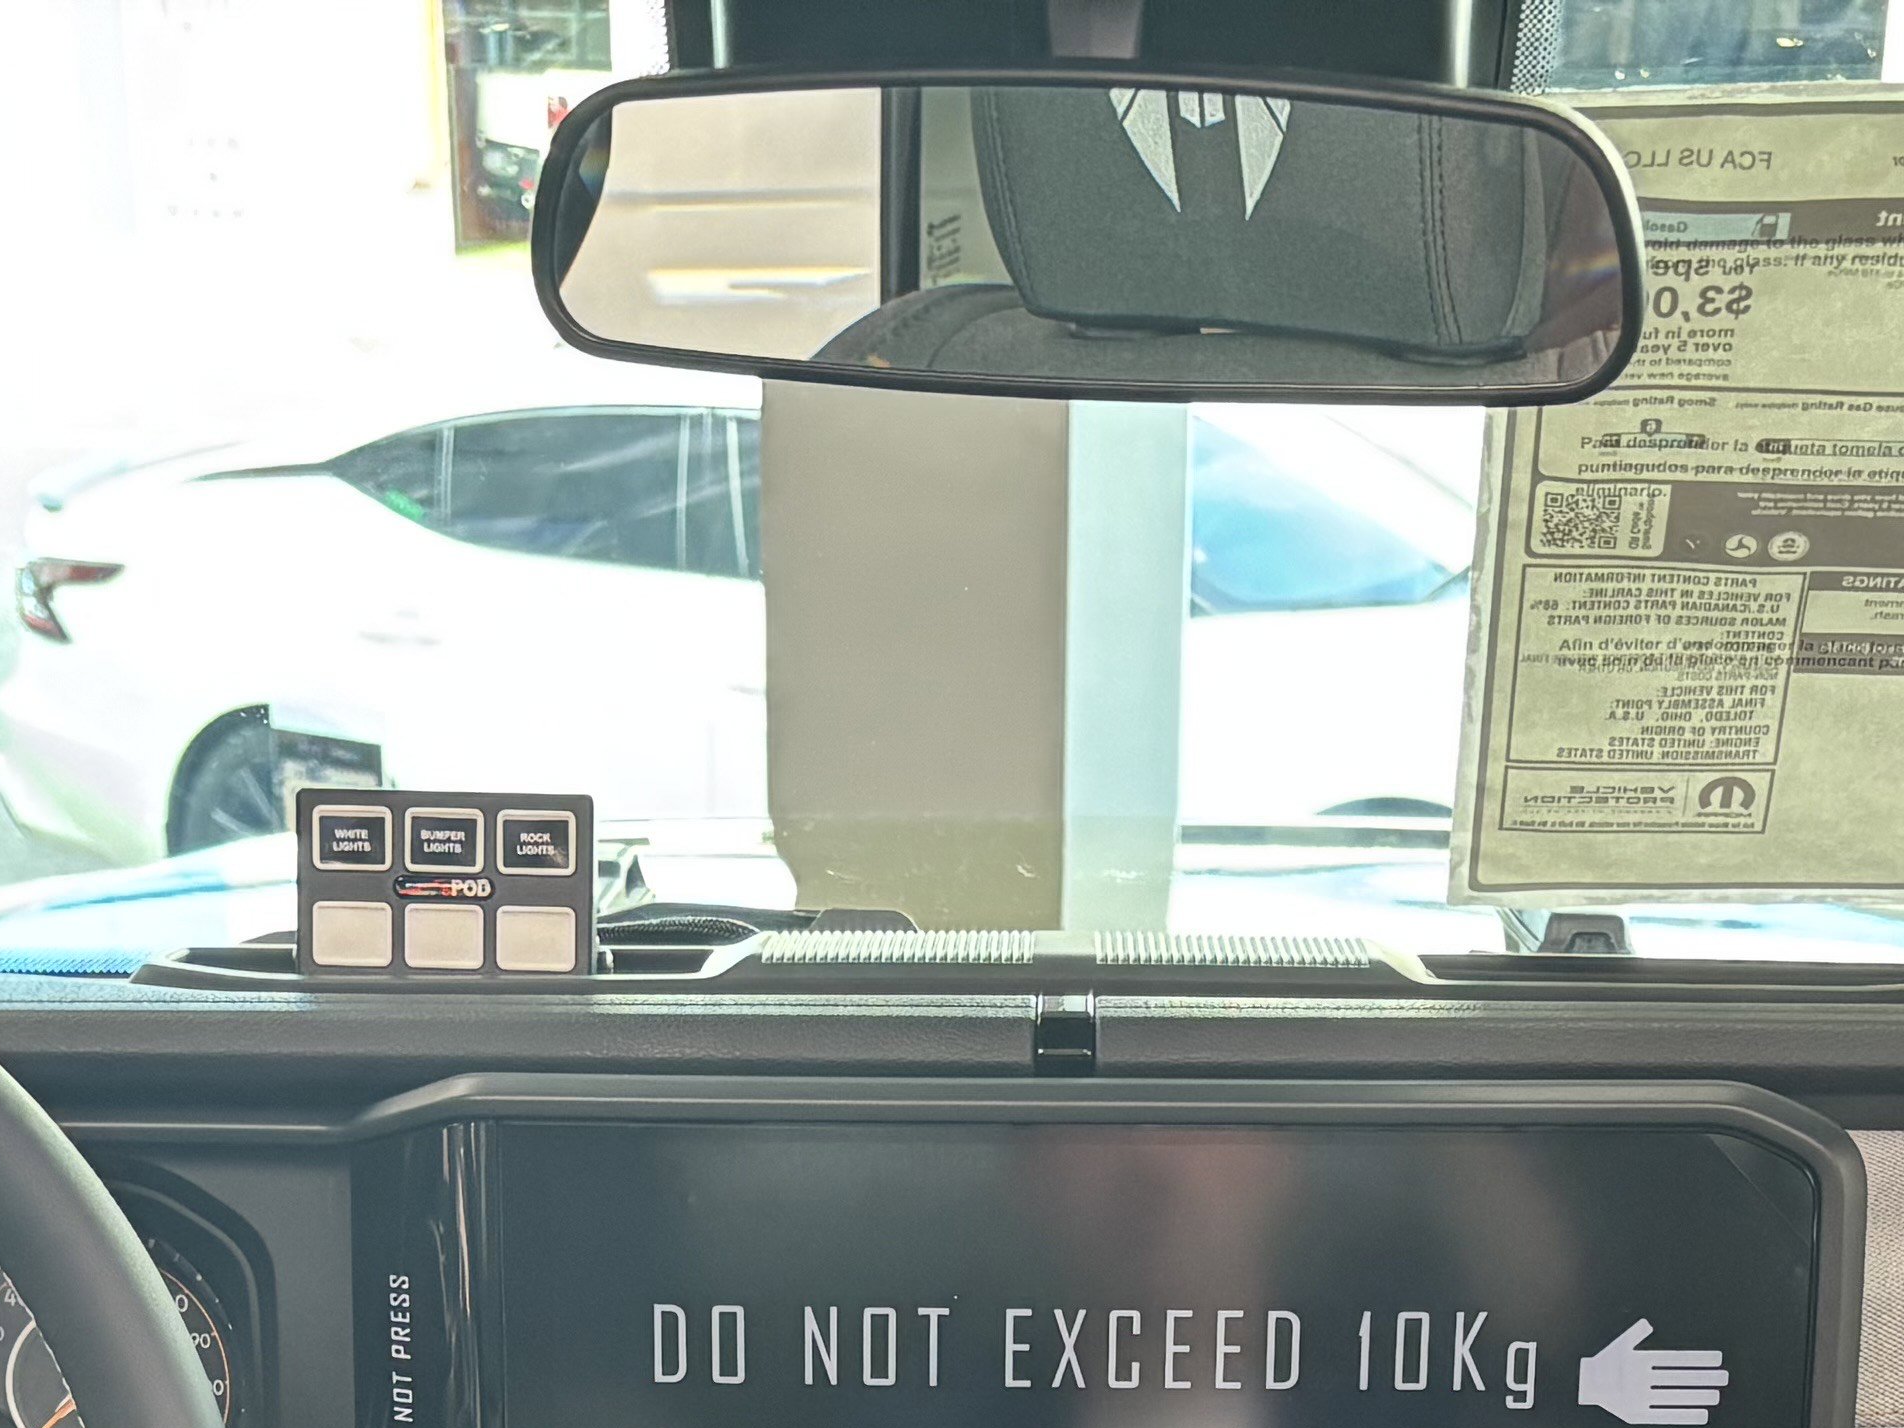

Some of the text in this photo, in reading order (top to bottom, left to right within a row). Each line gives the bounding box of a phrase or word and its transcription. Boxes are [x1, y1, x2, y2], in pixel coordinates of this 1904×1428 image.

[334, 828, 369, 841] WHITE
[419, 829, 466, 842] BUMPER
[519, 832, 551, 843] ROCK
[332, 840, 371, 853] LIGHTS
[423, 842, 462, 854] LIGHTS
[516, 844, 555, 856] LIGHTS
[389, 1274, 412, 1360] PRESS
[653, 1303, 1538, 1410] DO NOT EXCEED 10Kg
[392, 1371, 414, 1424] NOT
